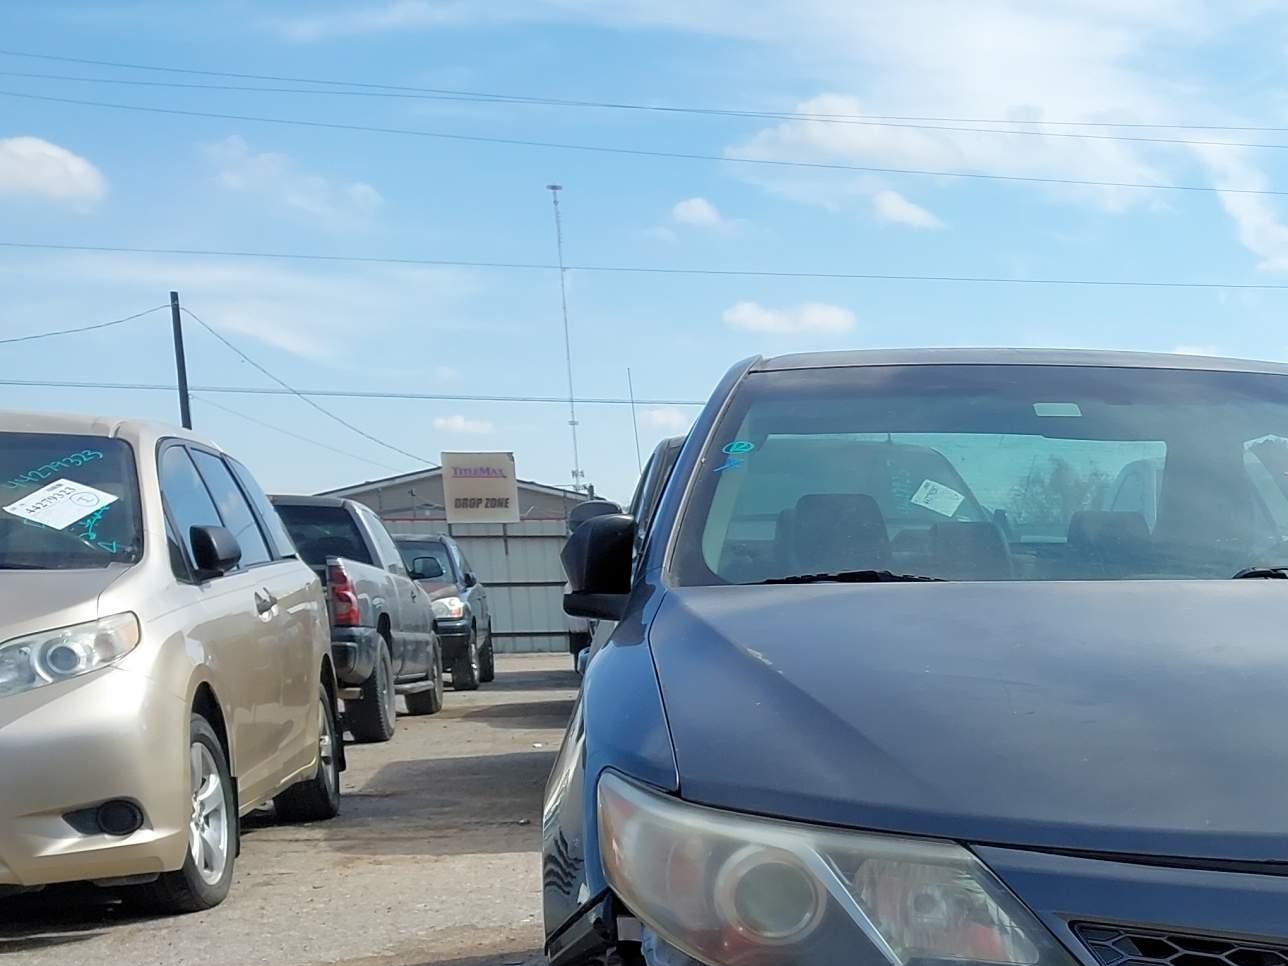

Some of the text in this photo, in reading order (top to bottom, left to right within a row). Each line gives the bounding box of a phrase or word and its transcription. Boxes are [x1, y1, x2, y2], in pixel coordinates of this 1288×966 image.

[25, 486, 77, 514] 44279323
[454, 497, 510, 509] DROP ZONE
